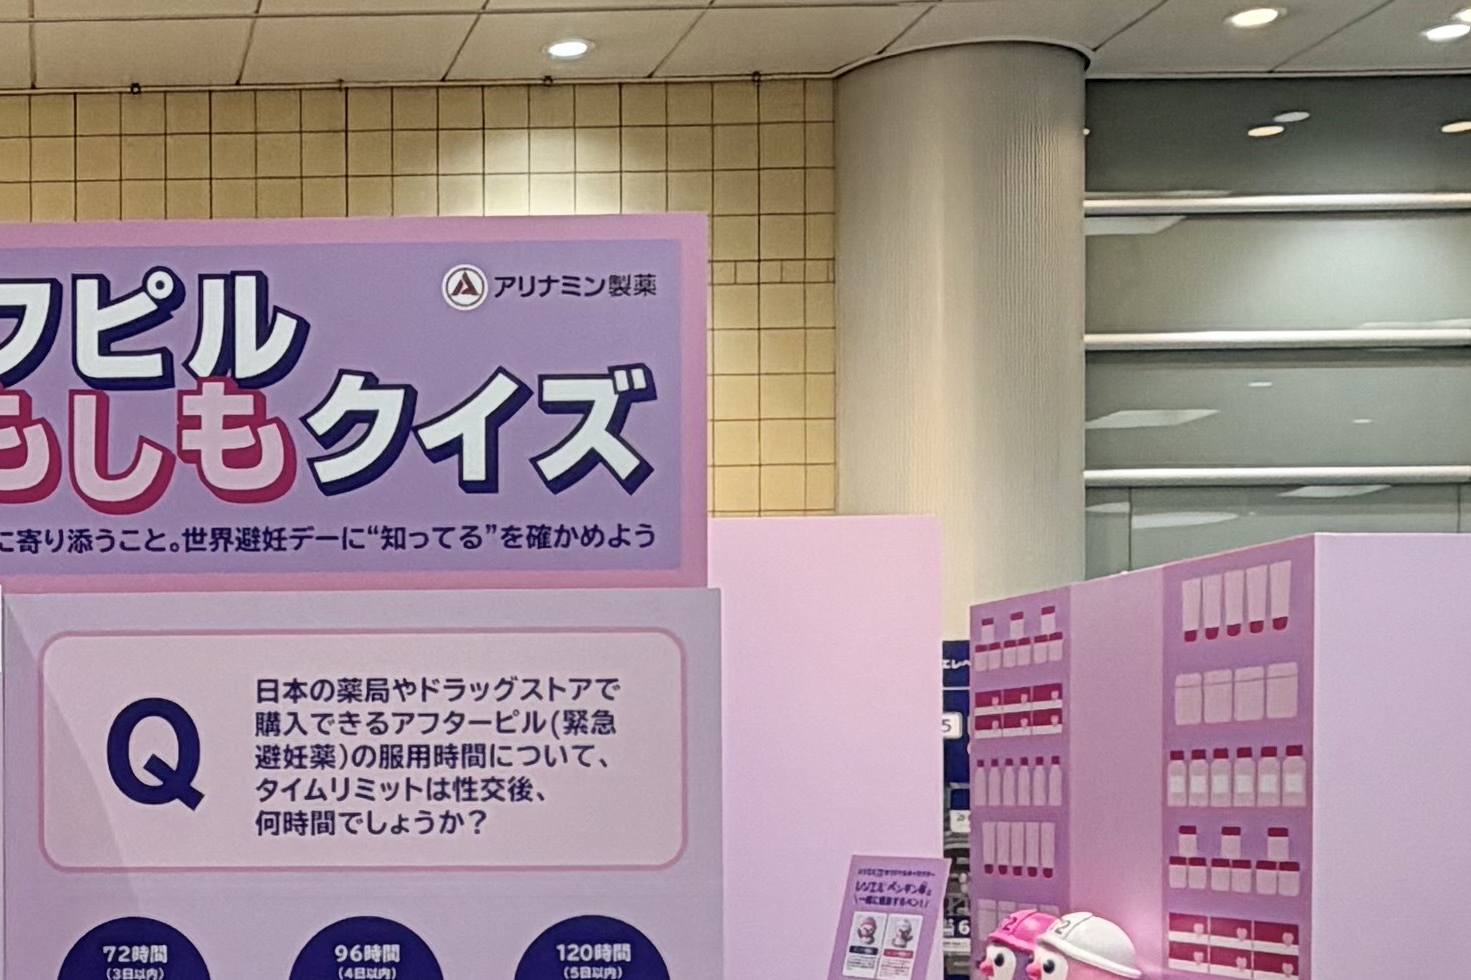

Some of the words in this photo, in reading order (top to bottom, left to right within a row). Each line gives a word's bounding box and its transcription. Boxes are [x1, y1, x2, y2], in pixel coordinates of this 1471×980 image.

[494, 273, 657, 298] アリナミン製薬
[255, 675, 622, 704] 日本の薬局やドラッグストアで
[254, 708, 618, 740] 購入できるアフターピル(緊急
[107, 697, 205, 811] Q
[254, 742, 610, 771] 避妊薬)の服用時間について、
[254, 775, 547, 803] タイムリミットは性交後、
[254, 809, 488, 837] 何時間でしょうか?
[102, 944, 168, 964] 72時間
[334, 944, 401, 963] 96時間
[555, 943, 632, 963] 120時間
[106, 967, 165, 980] (3日以内)
[338, 966, 396, 980] (4日以内)
[563, 966, 623, 980] (5日以内)
